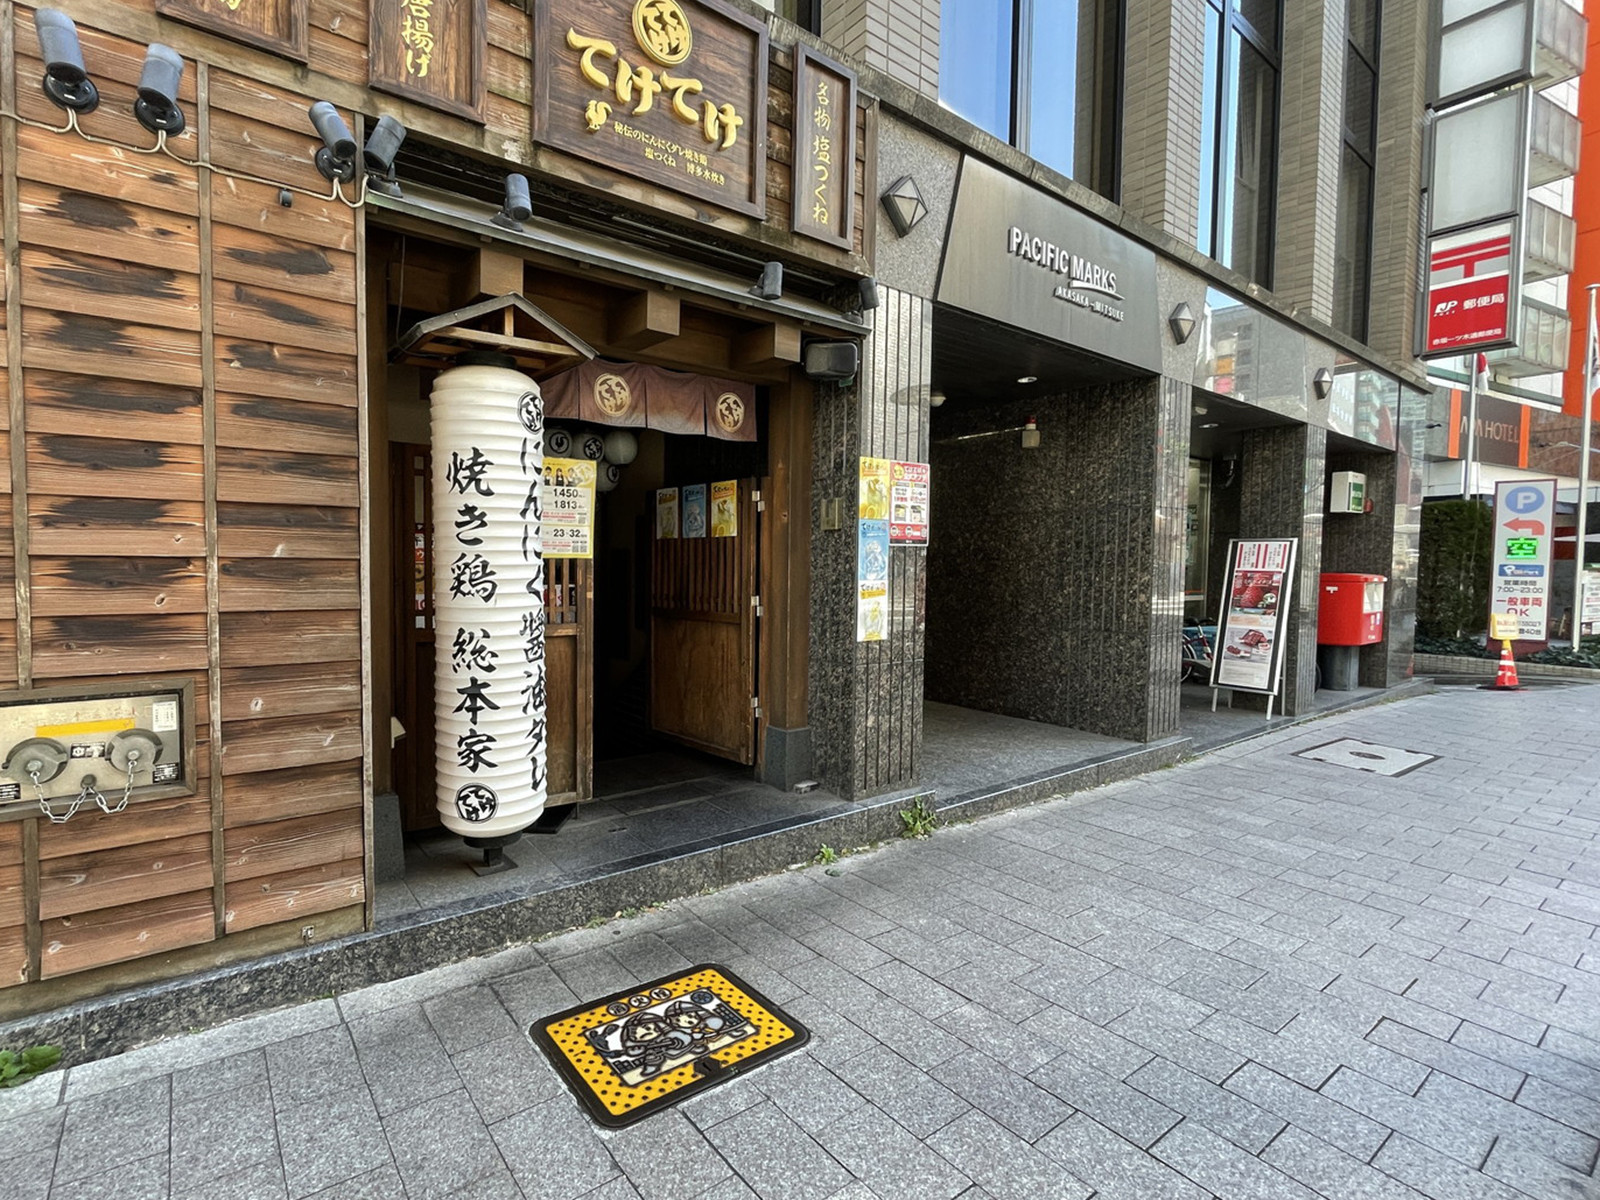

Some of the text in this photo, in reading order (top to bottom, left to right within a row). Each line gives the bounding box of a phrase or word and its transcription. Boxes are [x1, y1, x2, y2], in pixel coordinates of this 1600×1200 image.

[567, 27, 744, 151] てけてけ
[1008, 226, 1117, 293] PACIFIC MARKS
[1485, 420, 1519, 443] HOTEL
[446, 446, 497, 603] 焼き鶏
[452, 627, 501, 775] 総本家
